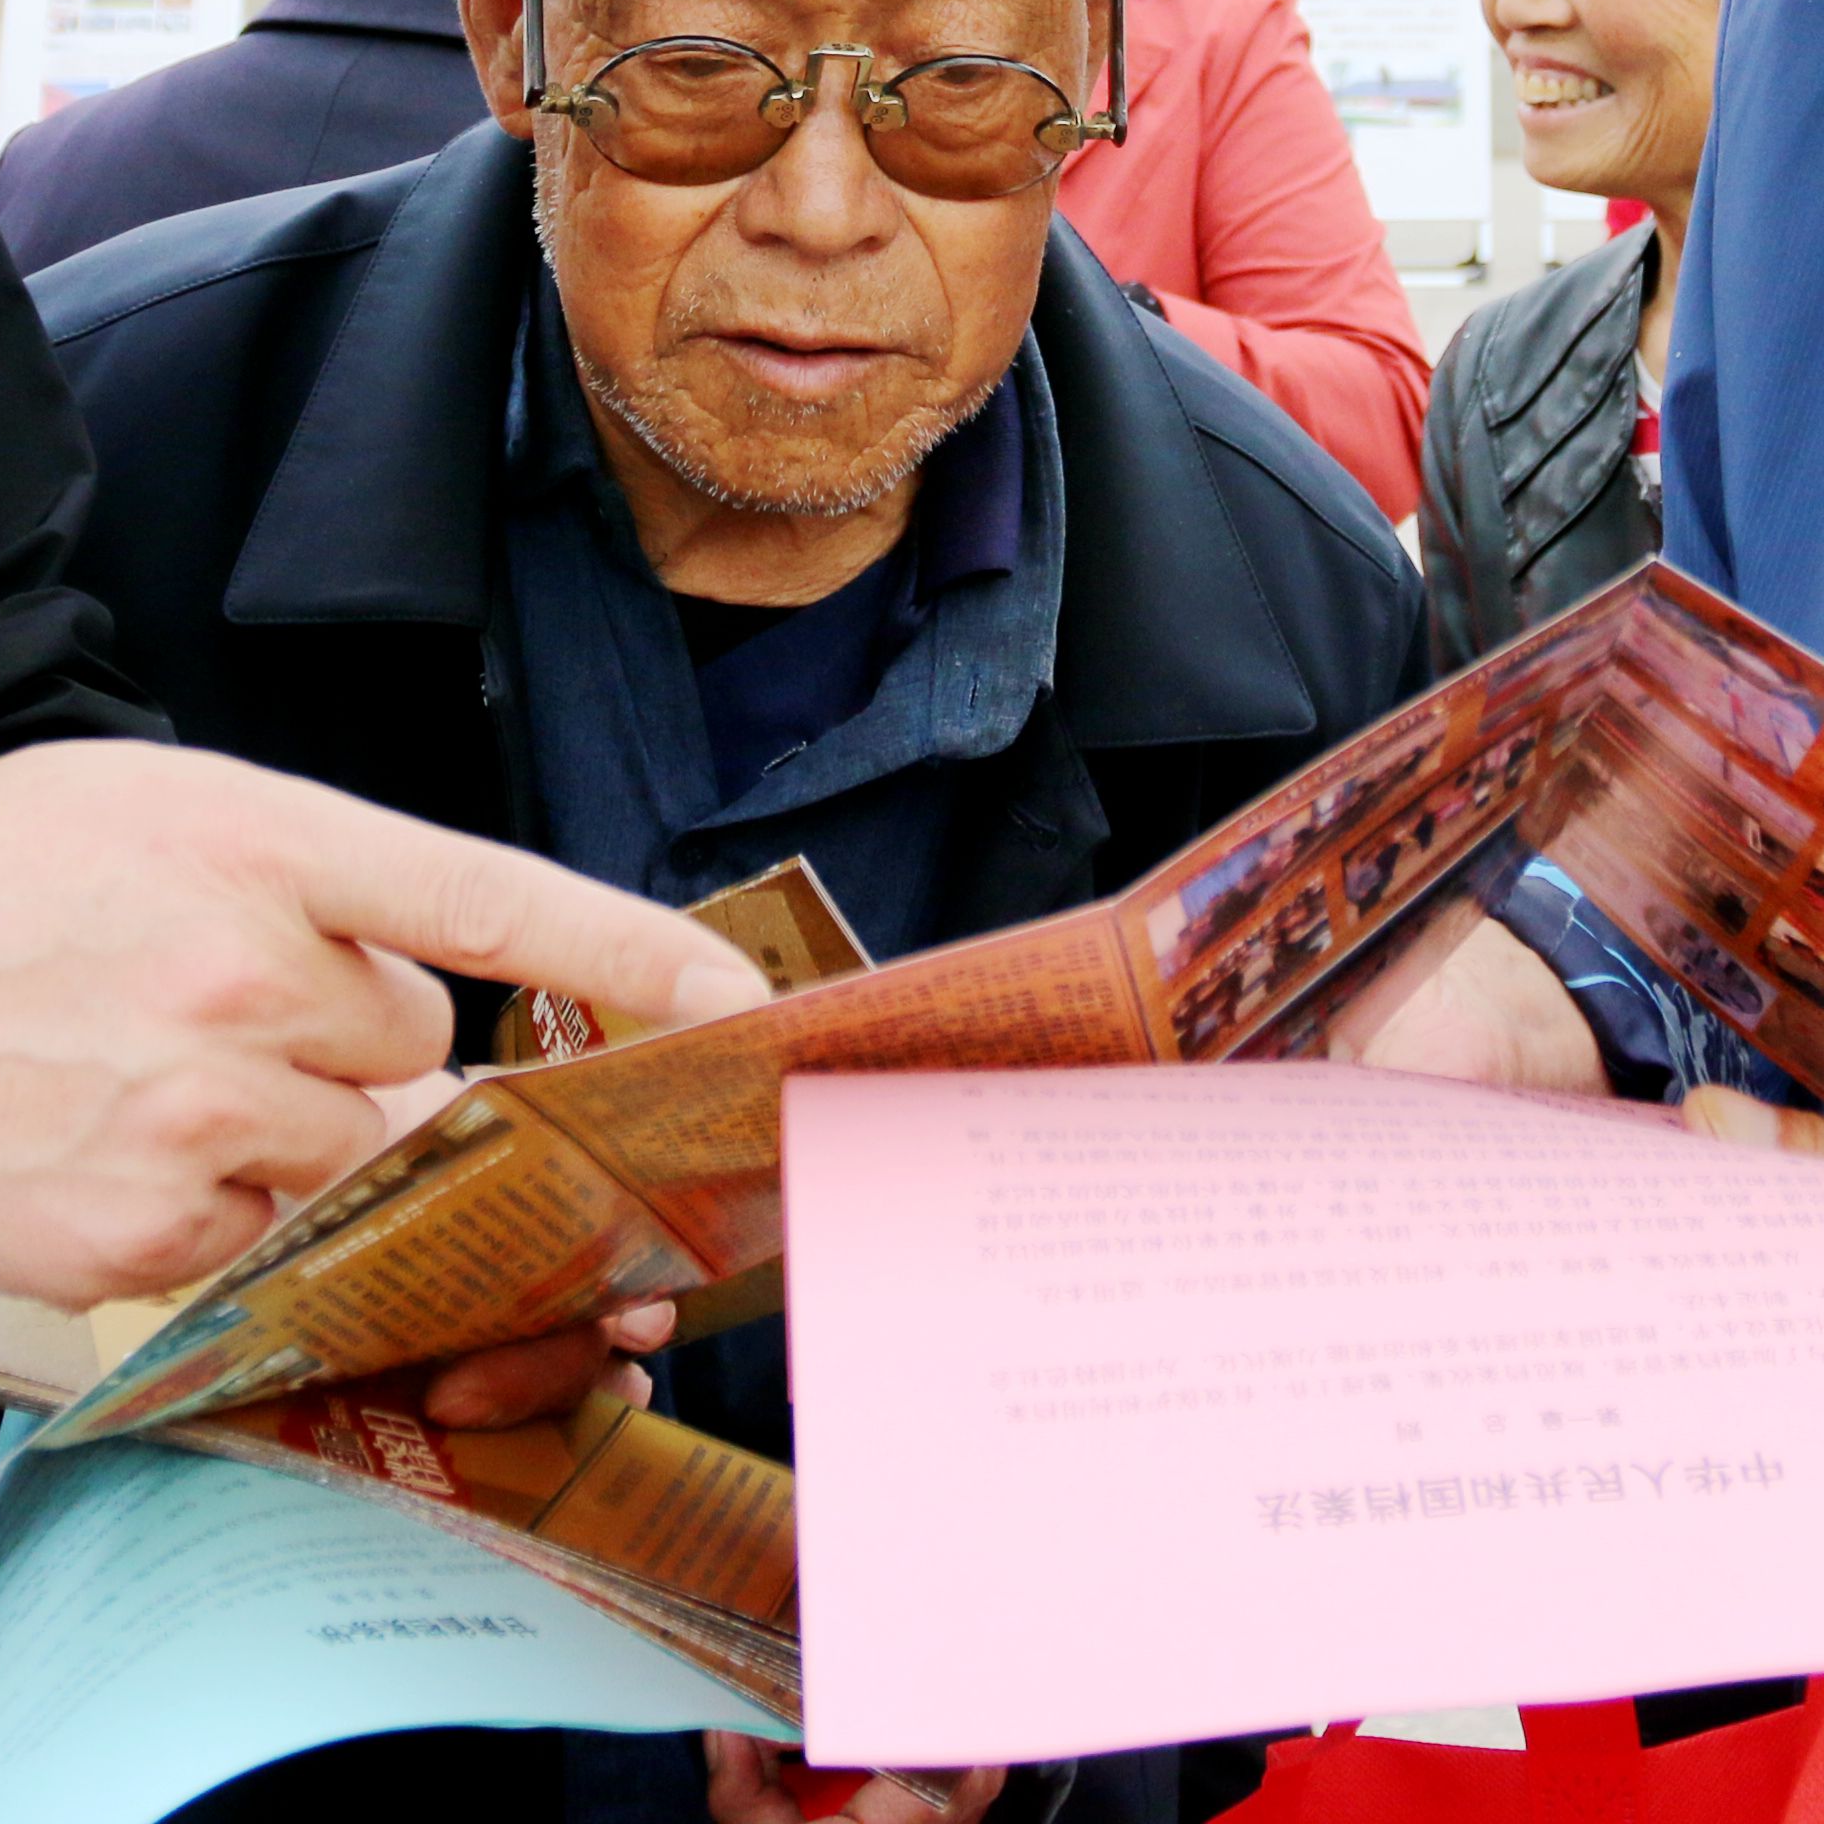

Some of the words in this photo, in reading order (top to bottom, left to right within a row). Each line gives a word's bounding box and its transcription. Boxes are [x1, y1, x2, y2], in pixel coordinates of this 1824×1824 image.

[1252, 1447, 1784, 1535] 中华人民共和国档案法
